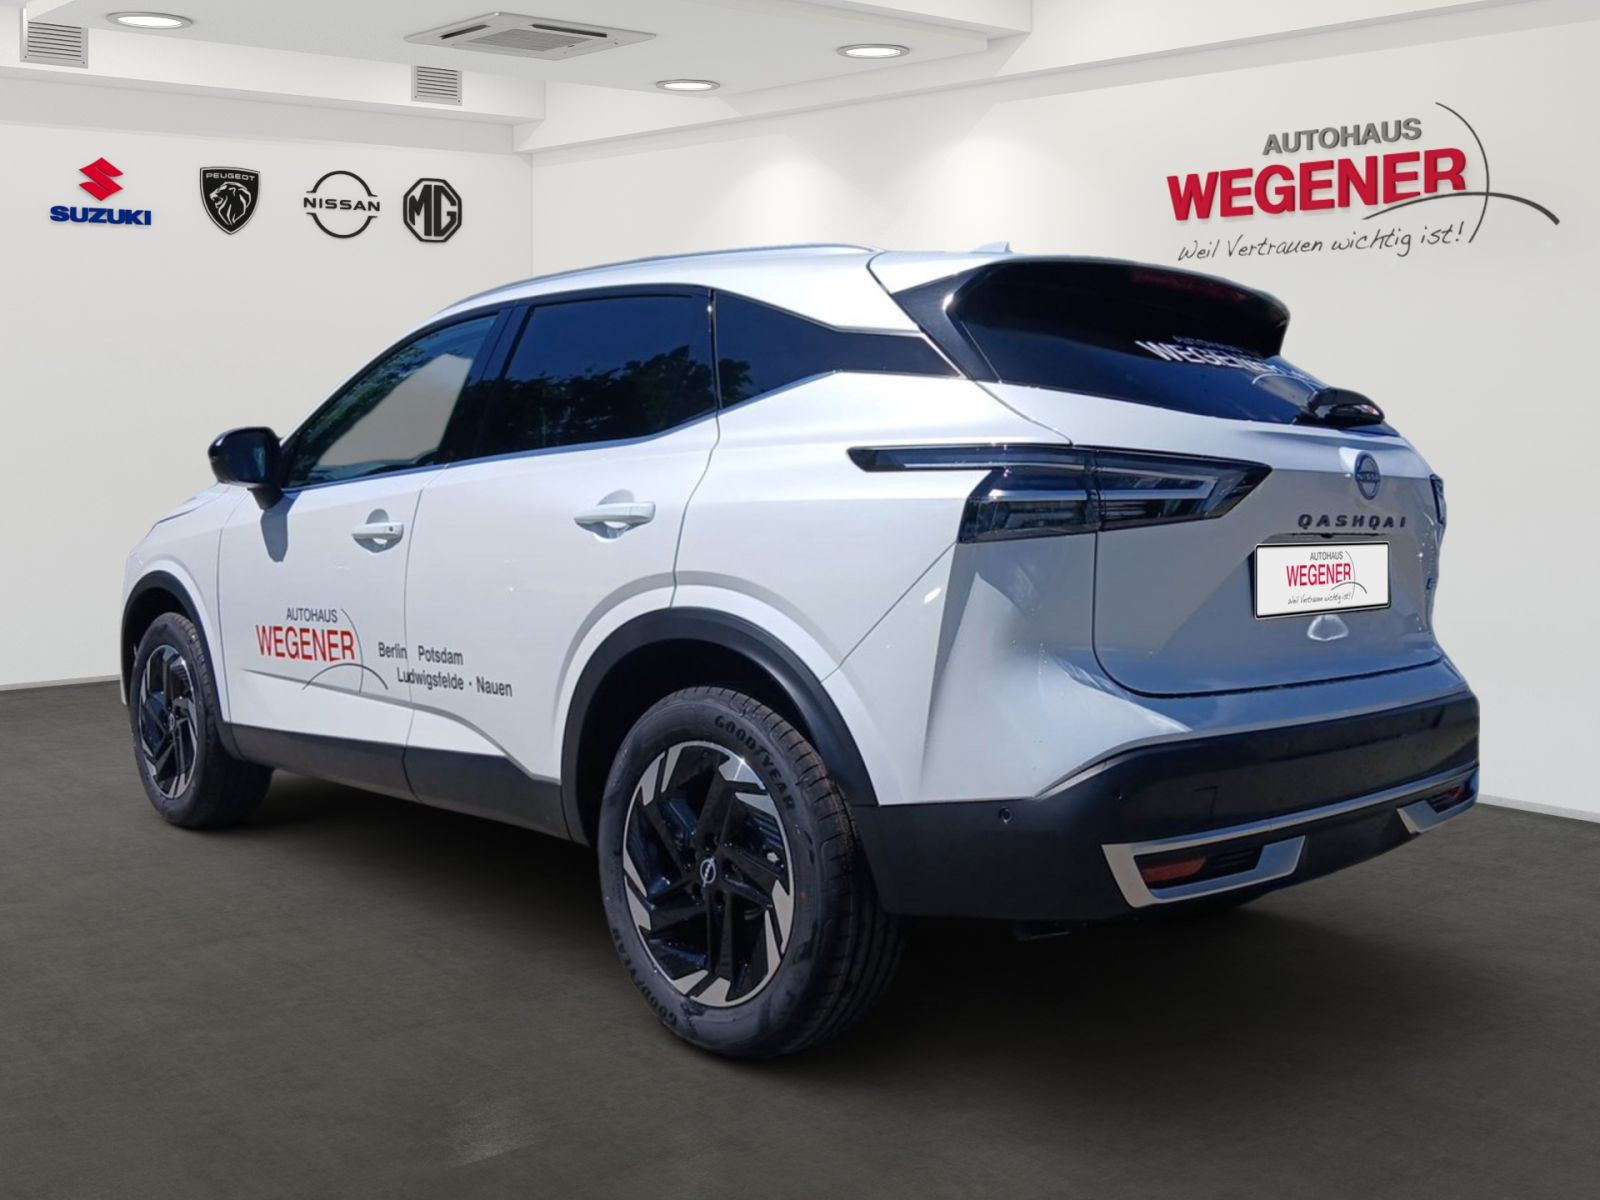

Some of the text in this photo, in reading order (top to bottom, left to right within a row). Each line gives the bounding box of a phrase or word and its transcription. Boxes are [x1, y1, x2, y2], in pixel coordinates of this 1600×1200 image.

[1262, 118, 1422, 156] AUTOHAUS
[205, 172, 256, 181] PEUGEOT
[1167, 148, 1467, 221] WEGENER
[50, 205, 152, 226] SUZUKI
[303, 196, 380, 212] NISSAN
[408, 183, 458, 237] MG
[1178, 221, 1464, 262] Weil Vertrauen wichtig ist!
[1298, 514, 1407, 530] QASHQAI
[1309, 551, 1344, 561] AUTOHAUS
[1286, 562, 1352, 587] WEGENER
[286, 607, 338, 623] AUTOHAUS
[256, 625, 356, 662] WEGENER
[378, 641, 464, 666] Berlin Potsdam
[397, 667, 513, 697] Ludwigsfelde Nauen
